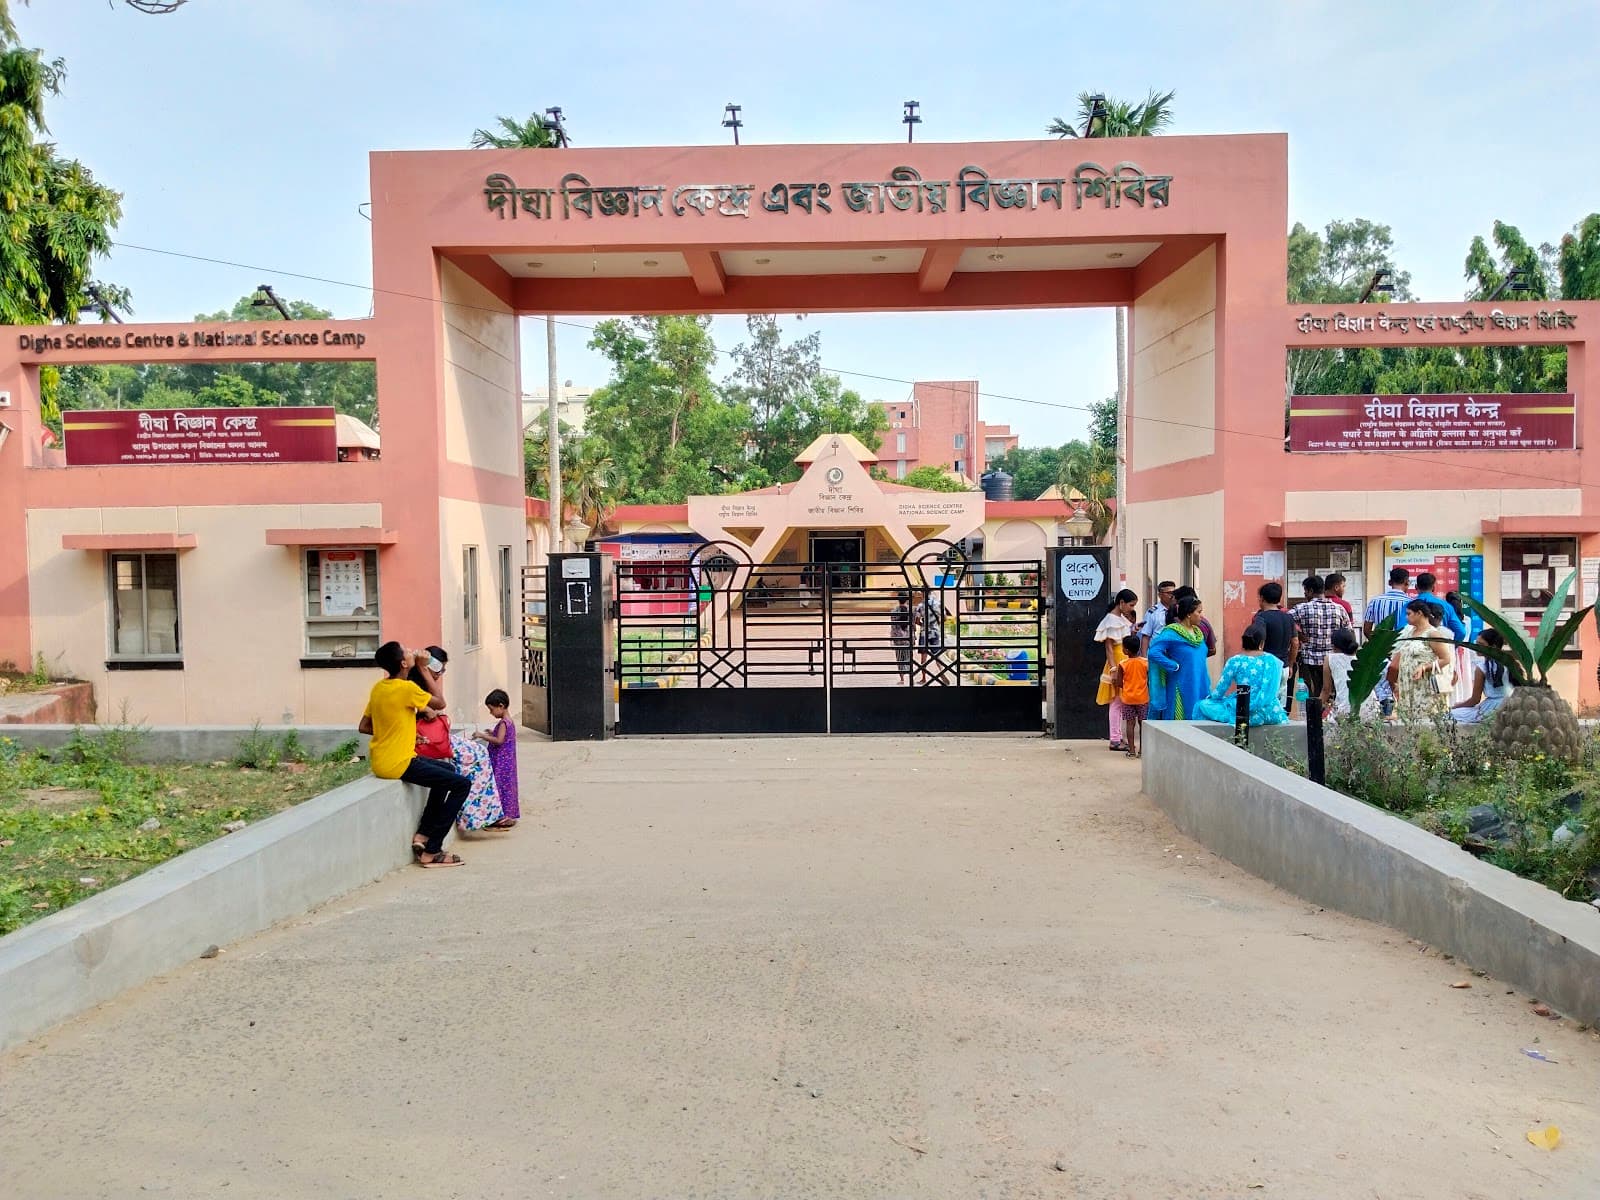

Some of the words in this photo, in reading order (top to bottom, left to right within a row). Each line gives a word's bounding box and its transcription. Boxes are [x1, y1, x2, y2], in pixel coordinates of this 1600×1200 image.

[484, 173, 556, 220] দীঘা
[560, 173, 666, 219] বিজ্ঞান
[672, 184, 755, 219] কেন্দ্র
[762, 182, 832, 214] এবং
[841, 165, 951, 213] জাতীয়
[957, 165, 1065, 211] বিজ্ঞান
[1072, 161, 1173, 209] শিবির
[1332, 312, 1375, 332] विज्ञान
[1490, 309, 1532, 331] विज्ञान
[1535, 309, 1577, 330] शिविर
[19, 334, 61, 354] Digha
[65, 333, 121, 349] Science
[125, 332, 174, 348] Centre
[178, 332, 189, 347] &
[194, 330, 257, 347] National
[261, 329, 319, 346] Science
[323, 329, 366, 349] Camp
[1364, 397, 1403, 420] दीघा
[1408, 399, 1460, 419] विज्ञान
[1465, 397, 1501, 419] केन्द्र
[138, 412, 168, 431] দীঘা
[173, 412, 217, 431] বিজ্ঞান
[223, 416, 258, 430] কেন্দ্র
[1402, 543, 1424, 551] Digha
